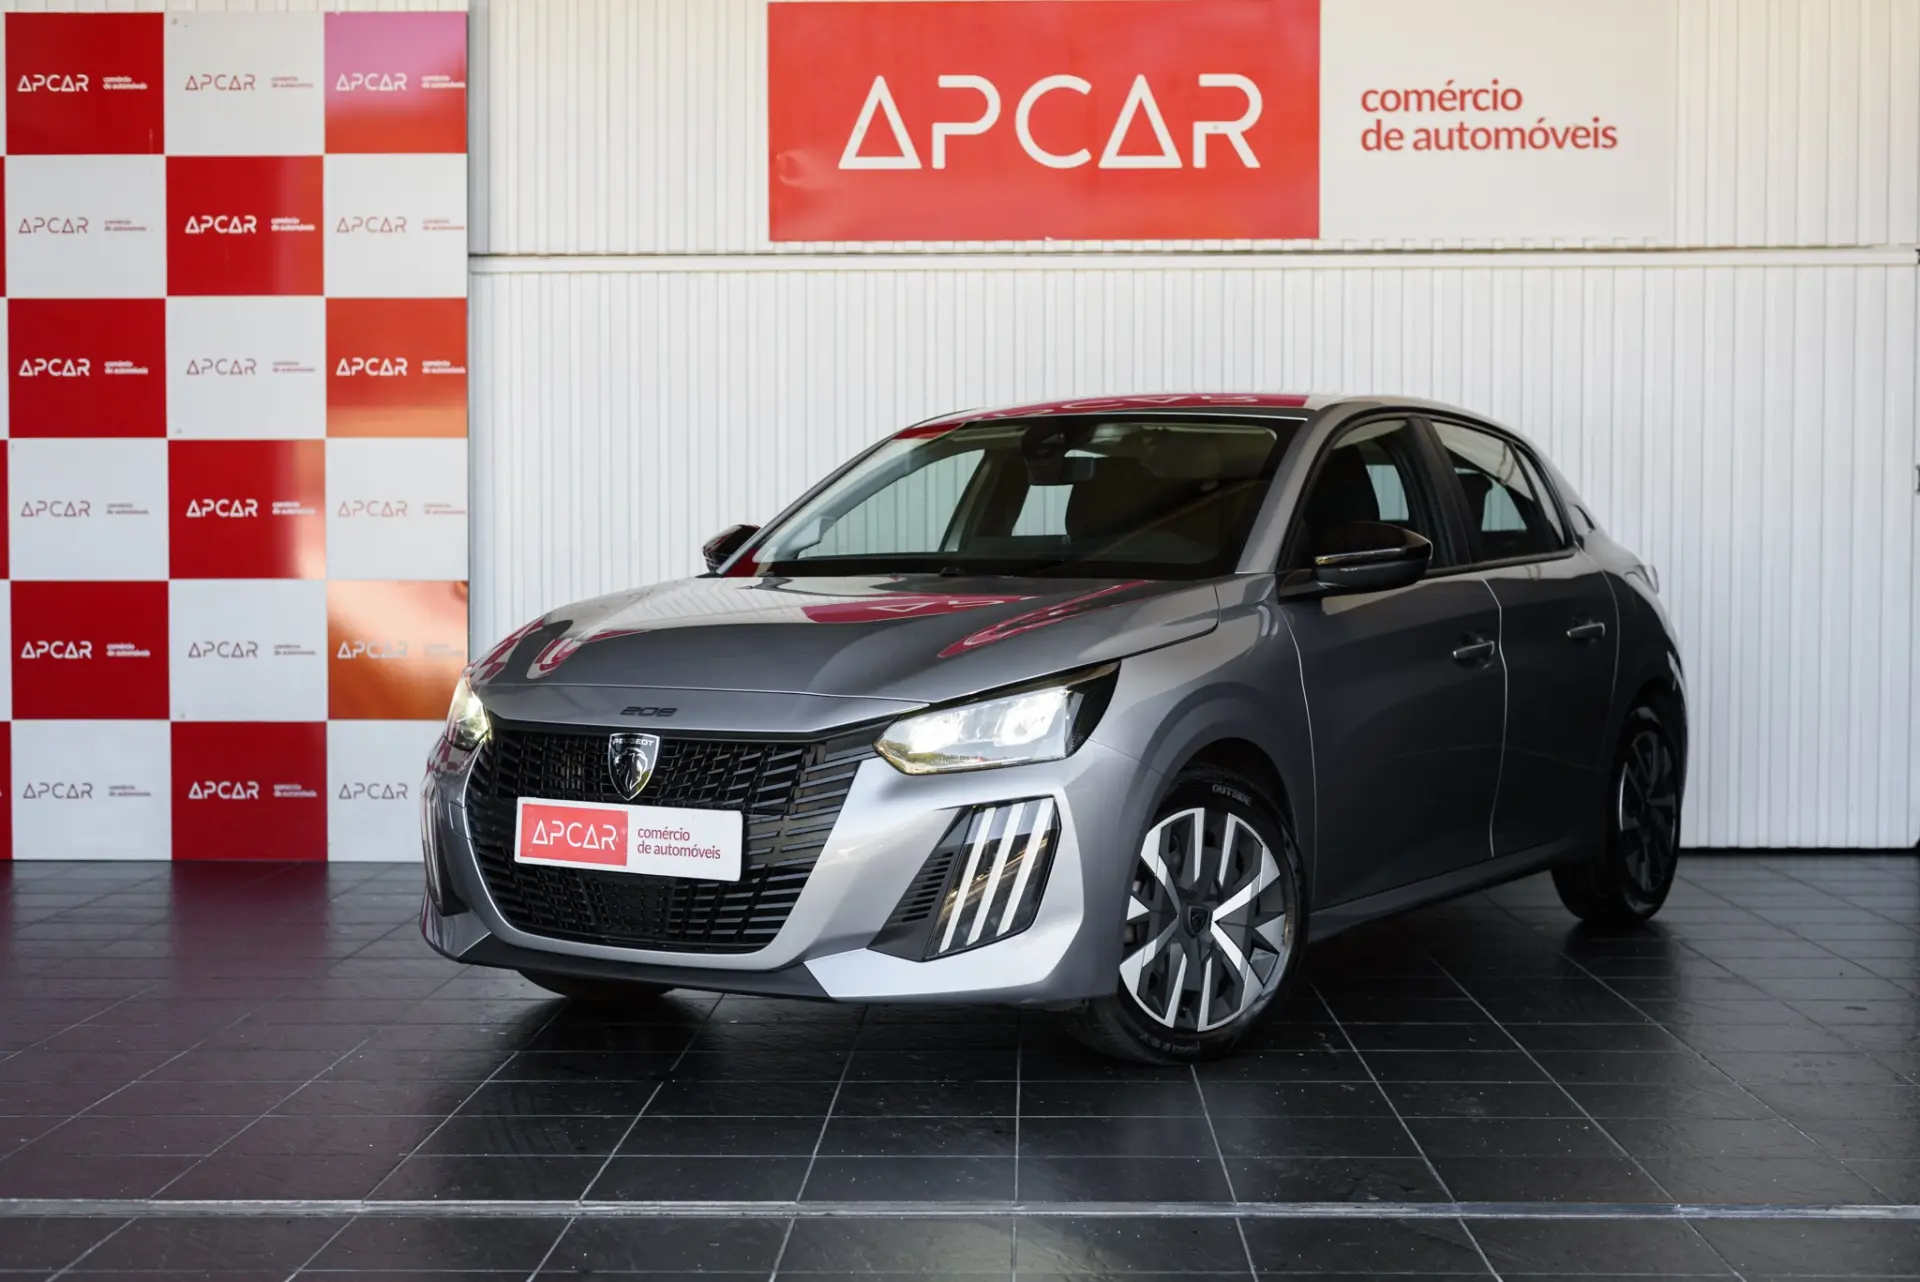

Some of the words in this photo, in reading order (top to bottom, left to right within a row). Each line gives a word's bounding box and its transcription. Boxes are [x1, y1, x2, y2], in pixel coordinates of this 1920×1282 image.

[18, 74, 89, 92] APCAR
[185, 74, 256, 91] APCAR
[335, 73, 408, 91] APCAR
[1361, 79, 1523, 112] comércio
[838, 74, 1263, 170] APCAR
[1361, 119, 1404, 151] de
[1412, 116, 1618, 150] automóveis
[19, 217, 89, 234] APCAR
[185, 215, 258, 234] APCAR
[336, 216, 407, 233] APCAR
[19, 358, 91, 377] APCAR
[186, 358, 257, 375] APCAR
[336, 357, 408, 376] APCAR
[20, 500, 91, 517] APCAR
[186, 498, 259, 518] APCAR
[338, 500, 408, 517] APCAR
[21, 641, 93, 659] APCAR
[188, 641, 258, 659] APCAR
[620, 706, 678, 717] 208
[23, 782, 93, 799] APCAR
[188, 781, 260, 800] APCAR
[338, 782, 408, 800] APCAR
[531, 819, 617, 850] APCAR
[637, 826, 690, 842] comércio
[637, 841, 651, 855] de
[653, 843, 721, 860] automóveis
